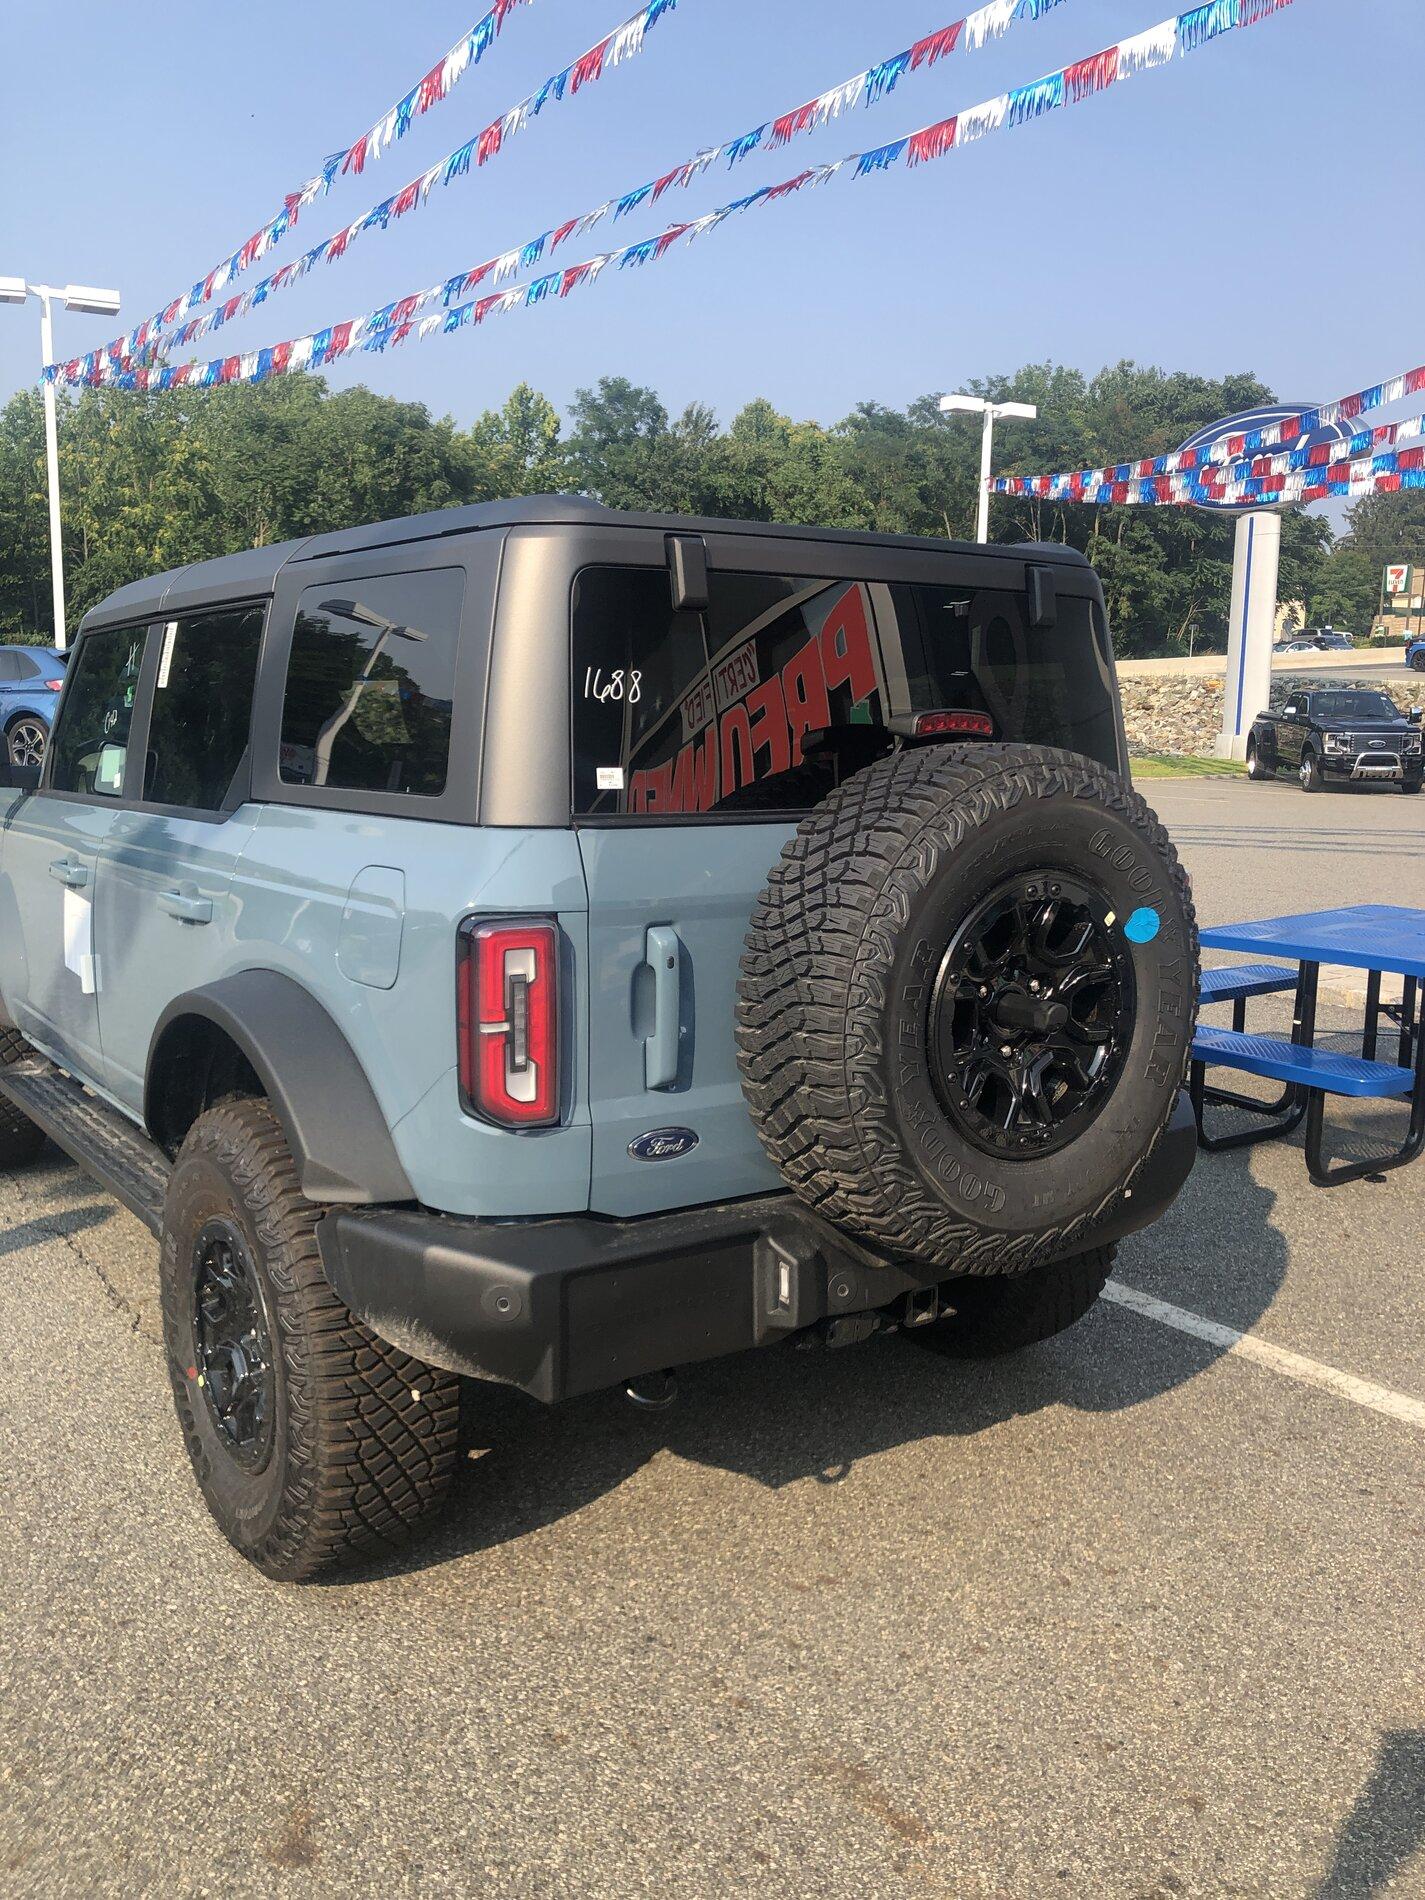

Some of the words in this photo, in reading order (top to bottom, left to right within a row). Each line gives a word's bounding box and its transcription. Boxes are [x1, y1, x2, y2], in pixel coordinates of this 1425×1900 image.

[1390, 568, 1404, 592] 7
[584, 666, 642, 703] 1688
[646, 1136, 685, 1157] Ford
